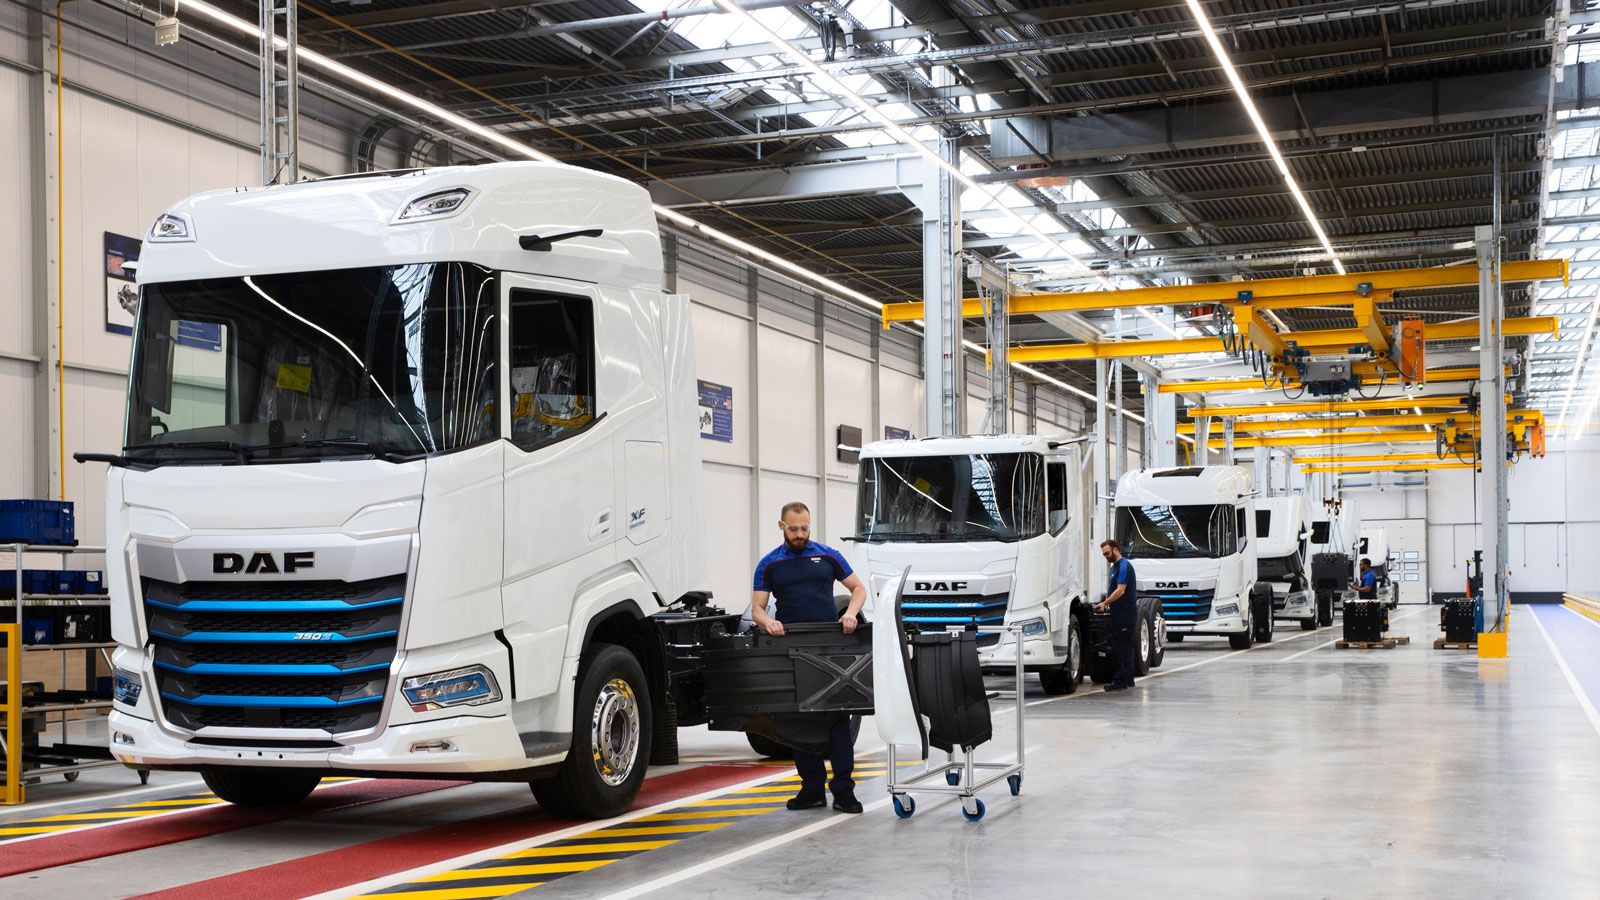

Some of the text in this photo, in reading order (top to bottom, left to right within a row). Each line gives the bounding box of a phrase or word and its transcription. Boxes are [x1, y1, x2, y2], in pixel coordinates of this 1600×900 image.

[631, 507, 645, 521] XF
[212, 551, 315, 574] DAF
[915, 581, 968, 591] DAF
[1155, 581, 1189, 589] DAF
